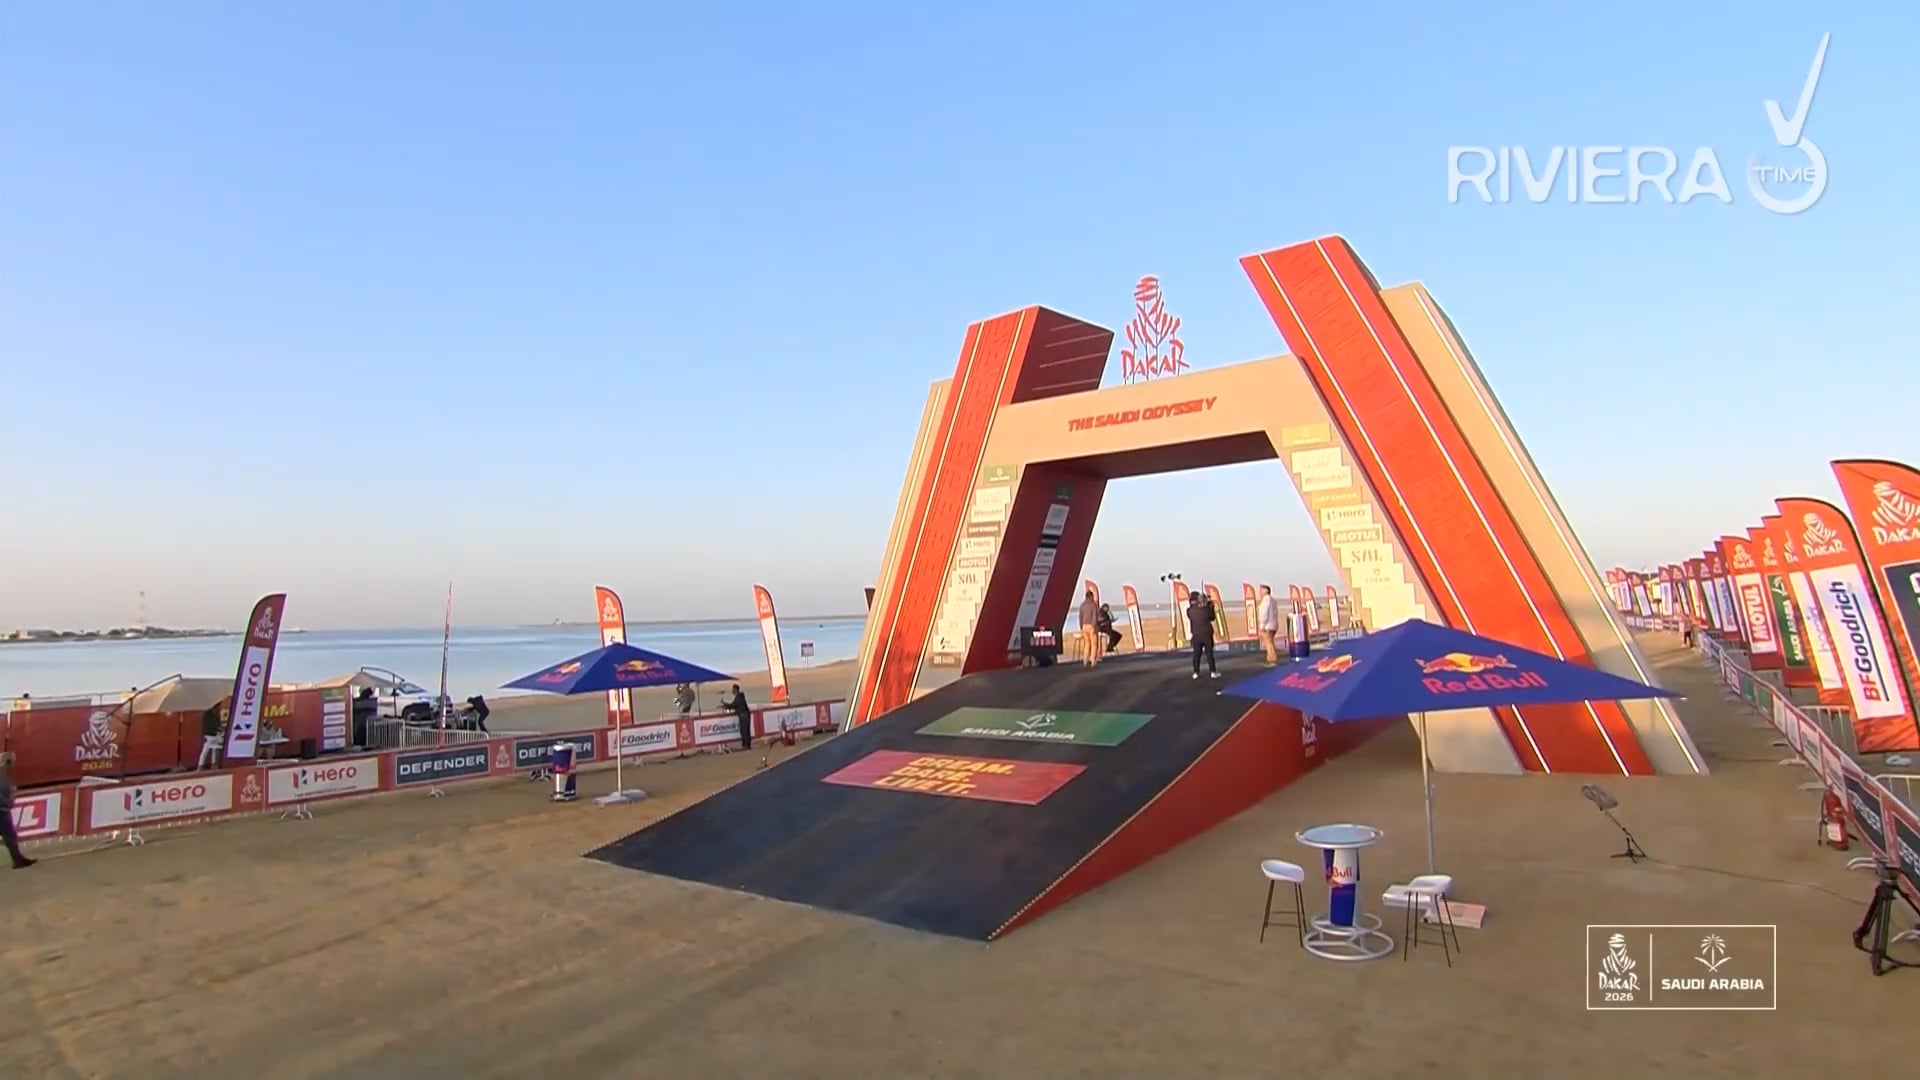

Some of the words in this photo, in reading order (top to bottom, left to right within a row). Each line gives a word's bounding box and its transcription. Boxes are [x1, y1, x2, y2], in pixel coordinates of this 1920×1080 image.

[1121, 339, 1190, 380] DAKAR
[1068, 416, 1095, 432] THE
[1095, 409, 1141, 428] SAUDI
[1142, 396, 1218, 420] ODYSSEY
[1336, 530, 1379, 543] MOTUL
[1803, 539, 1848, 558] DAKAR
[959, 558, 989, 569] MOTUL
[1744, 586, 1769, 640] MOTUL
[1829, 581, 1881, 701] BFGoodrich
[241, 663, 262, 716] Hero
[1422, 674, 1490, 694] Red
[1483, 671, 1549, 689] Bull
[960, 727, 1011, 736] SAUDI
[1010, 730, 1075, 740] ARABIA
[75, 743, 121, 761] DAKAR
[519, 741, 592, 760] DEFEER
[82, 761, 113, 770] 2026
[400, 753, 486, 775] DEFENDER
[909, 756, 1015, 774] DREAM.
[314, 766, 357, 782] Hero
[891, 766, 974, 782] DARE.
[151, 784, 206, 804] Hero
[873, 776, 943, 790] LIVE
[936, 782, 977, 794] IT.
